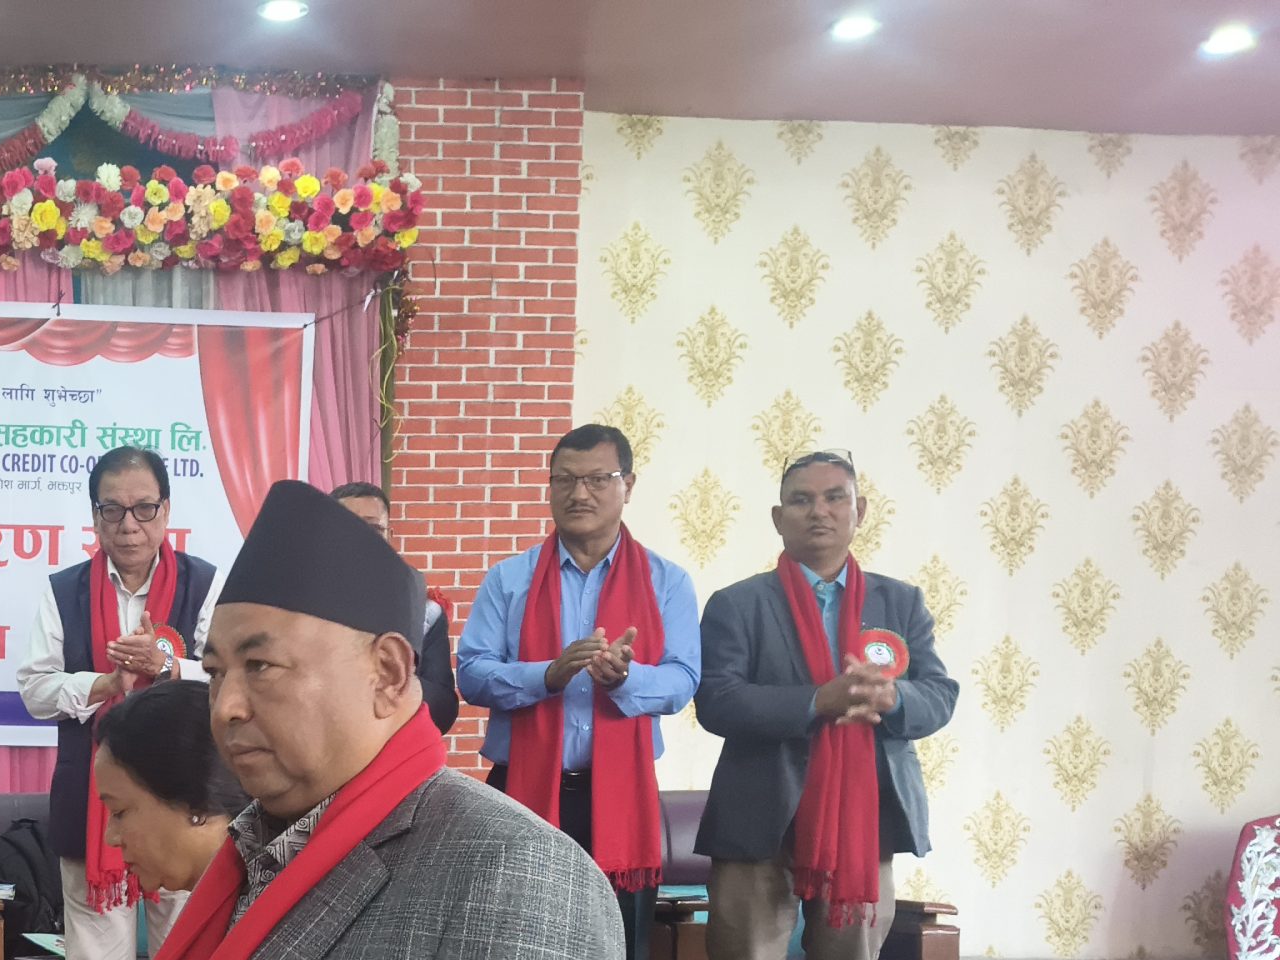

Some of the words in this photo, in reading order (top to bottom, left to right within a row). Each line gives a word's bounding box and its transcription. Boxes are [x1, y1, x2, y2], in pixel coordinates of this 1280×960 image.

[2, 383, 35, 400] लागि
[96, 422, 162, 450] संस्था
[170, 422, 207, 451] लि.
[2, 453, 56, 473] CREDIT
[173, 458, 204, 477] LTD.
